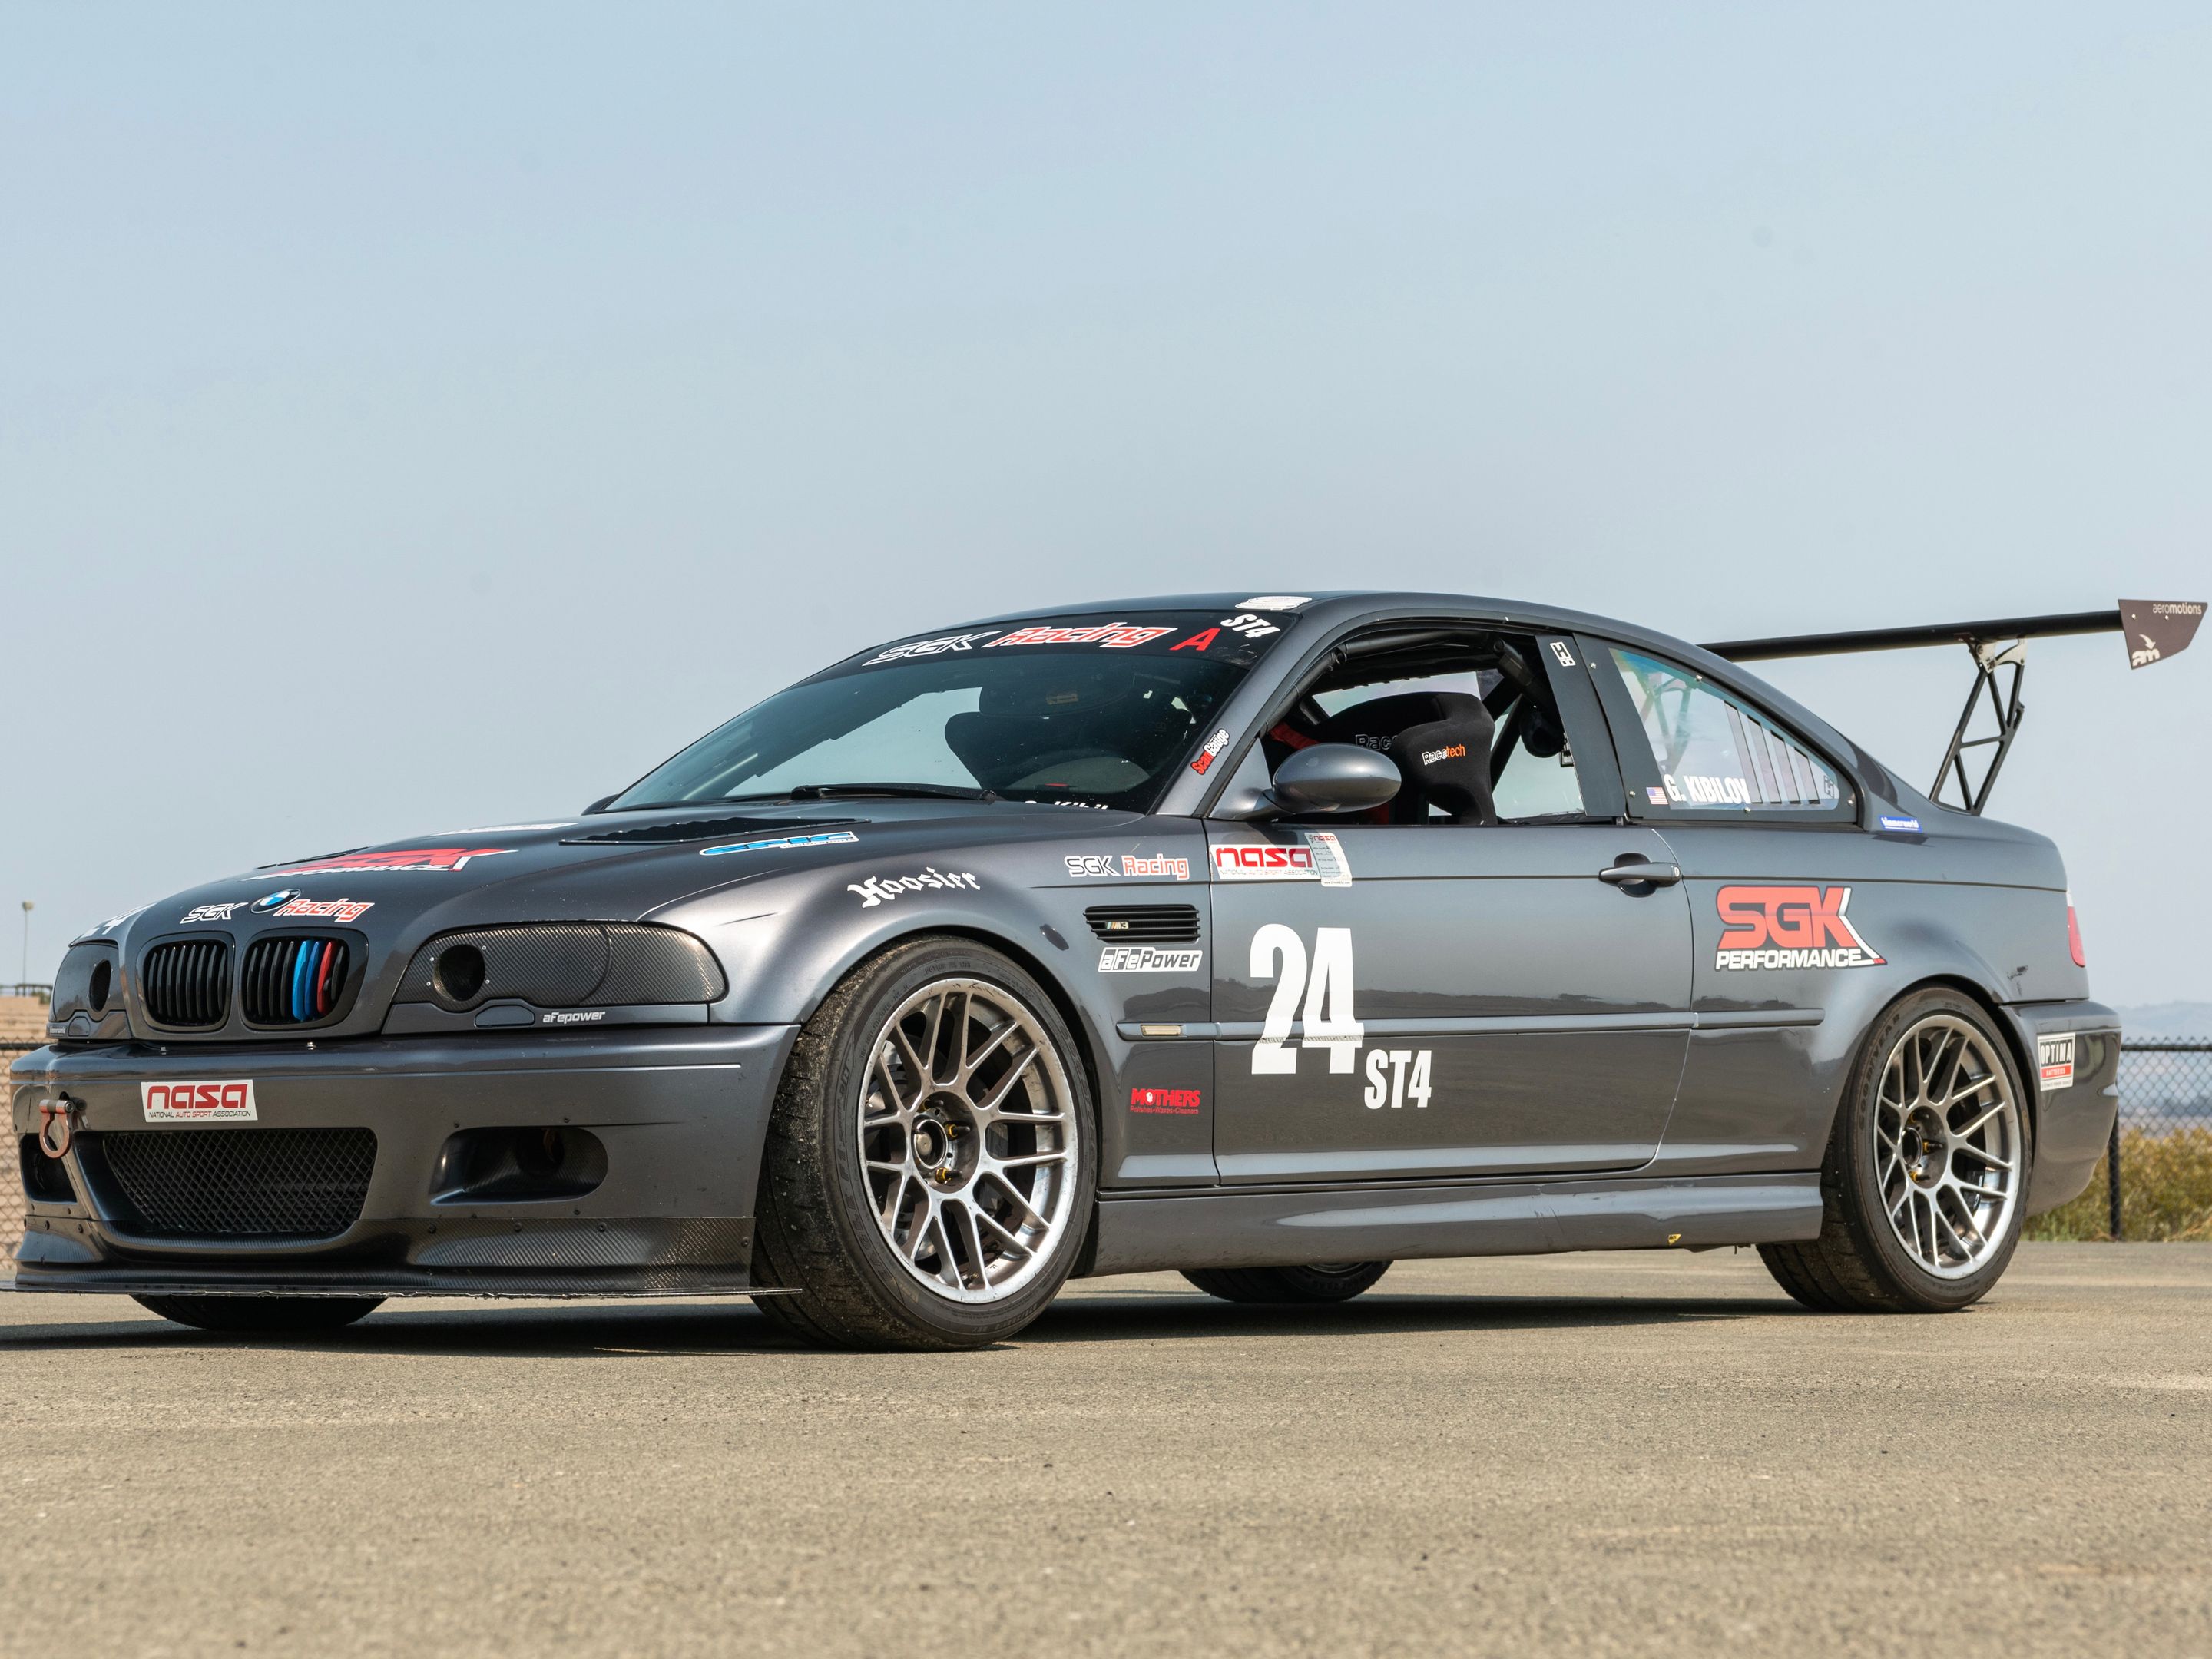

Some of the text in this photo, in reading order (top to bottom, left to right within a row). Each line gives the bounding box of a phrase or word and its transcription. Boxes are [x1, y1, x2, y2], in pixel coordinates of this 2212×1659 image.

[2153, 602, 2202, 614] aeromotions
[1220, 614, 1281, 639] ST4
[862, 622, 1177, 666] SGK Racing
[1169, 628, 1221, 651] A
[1191, 729, 1230, 775] ScanGauge
[1356, 734, 1399, 751] Rac
[1422, 743, 1465, 766] Racetech
[1664, 774, 1751, 804] G. KIBILOV
[1064, 854, 1189, 880] SGK Racing
[1216, 848, 1313, 867] nasa
[847, 867, 981, 908] Hoosier
[180, 902, 248, 924] SGK
[273, 898, 374, 922] Racing
[1717, 886, 1855, 950] SGK
[1715, 948, 1862, 970] PERFORMANCE
[1250, 923, 1365, 1075] 24
[2041, 1042, 2071, 1065] OPTIMA
[1364, 1049, 1432, 1110] ST4
[147, 1084, 248, 1109] nasa
[1131, 1088, 1201, 1107] MOTHERS
